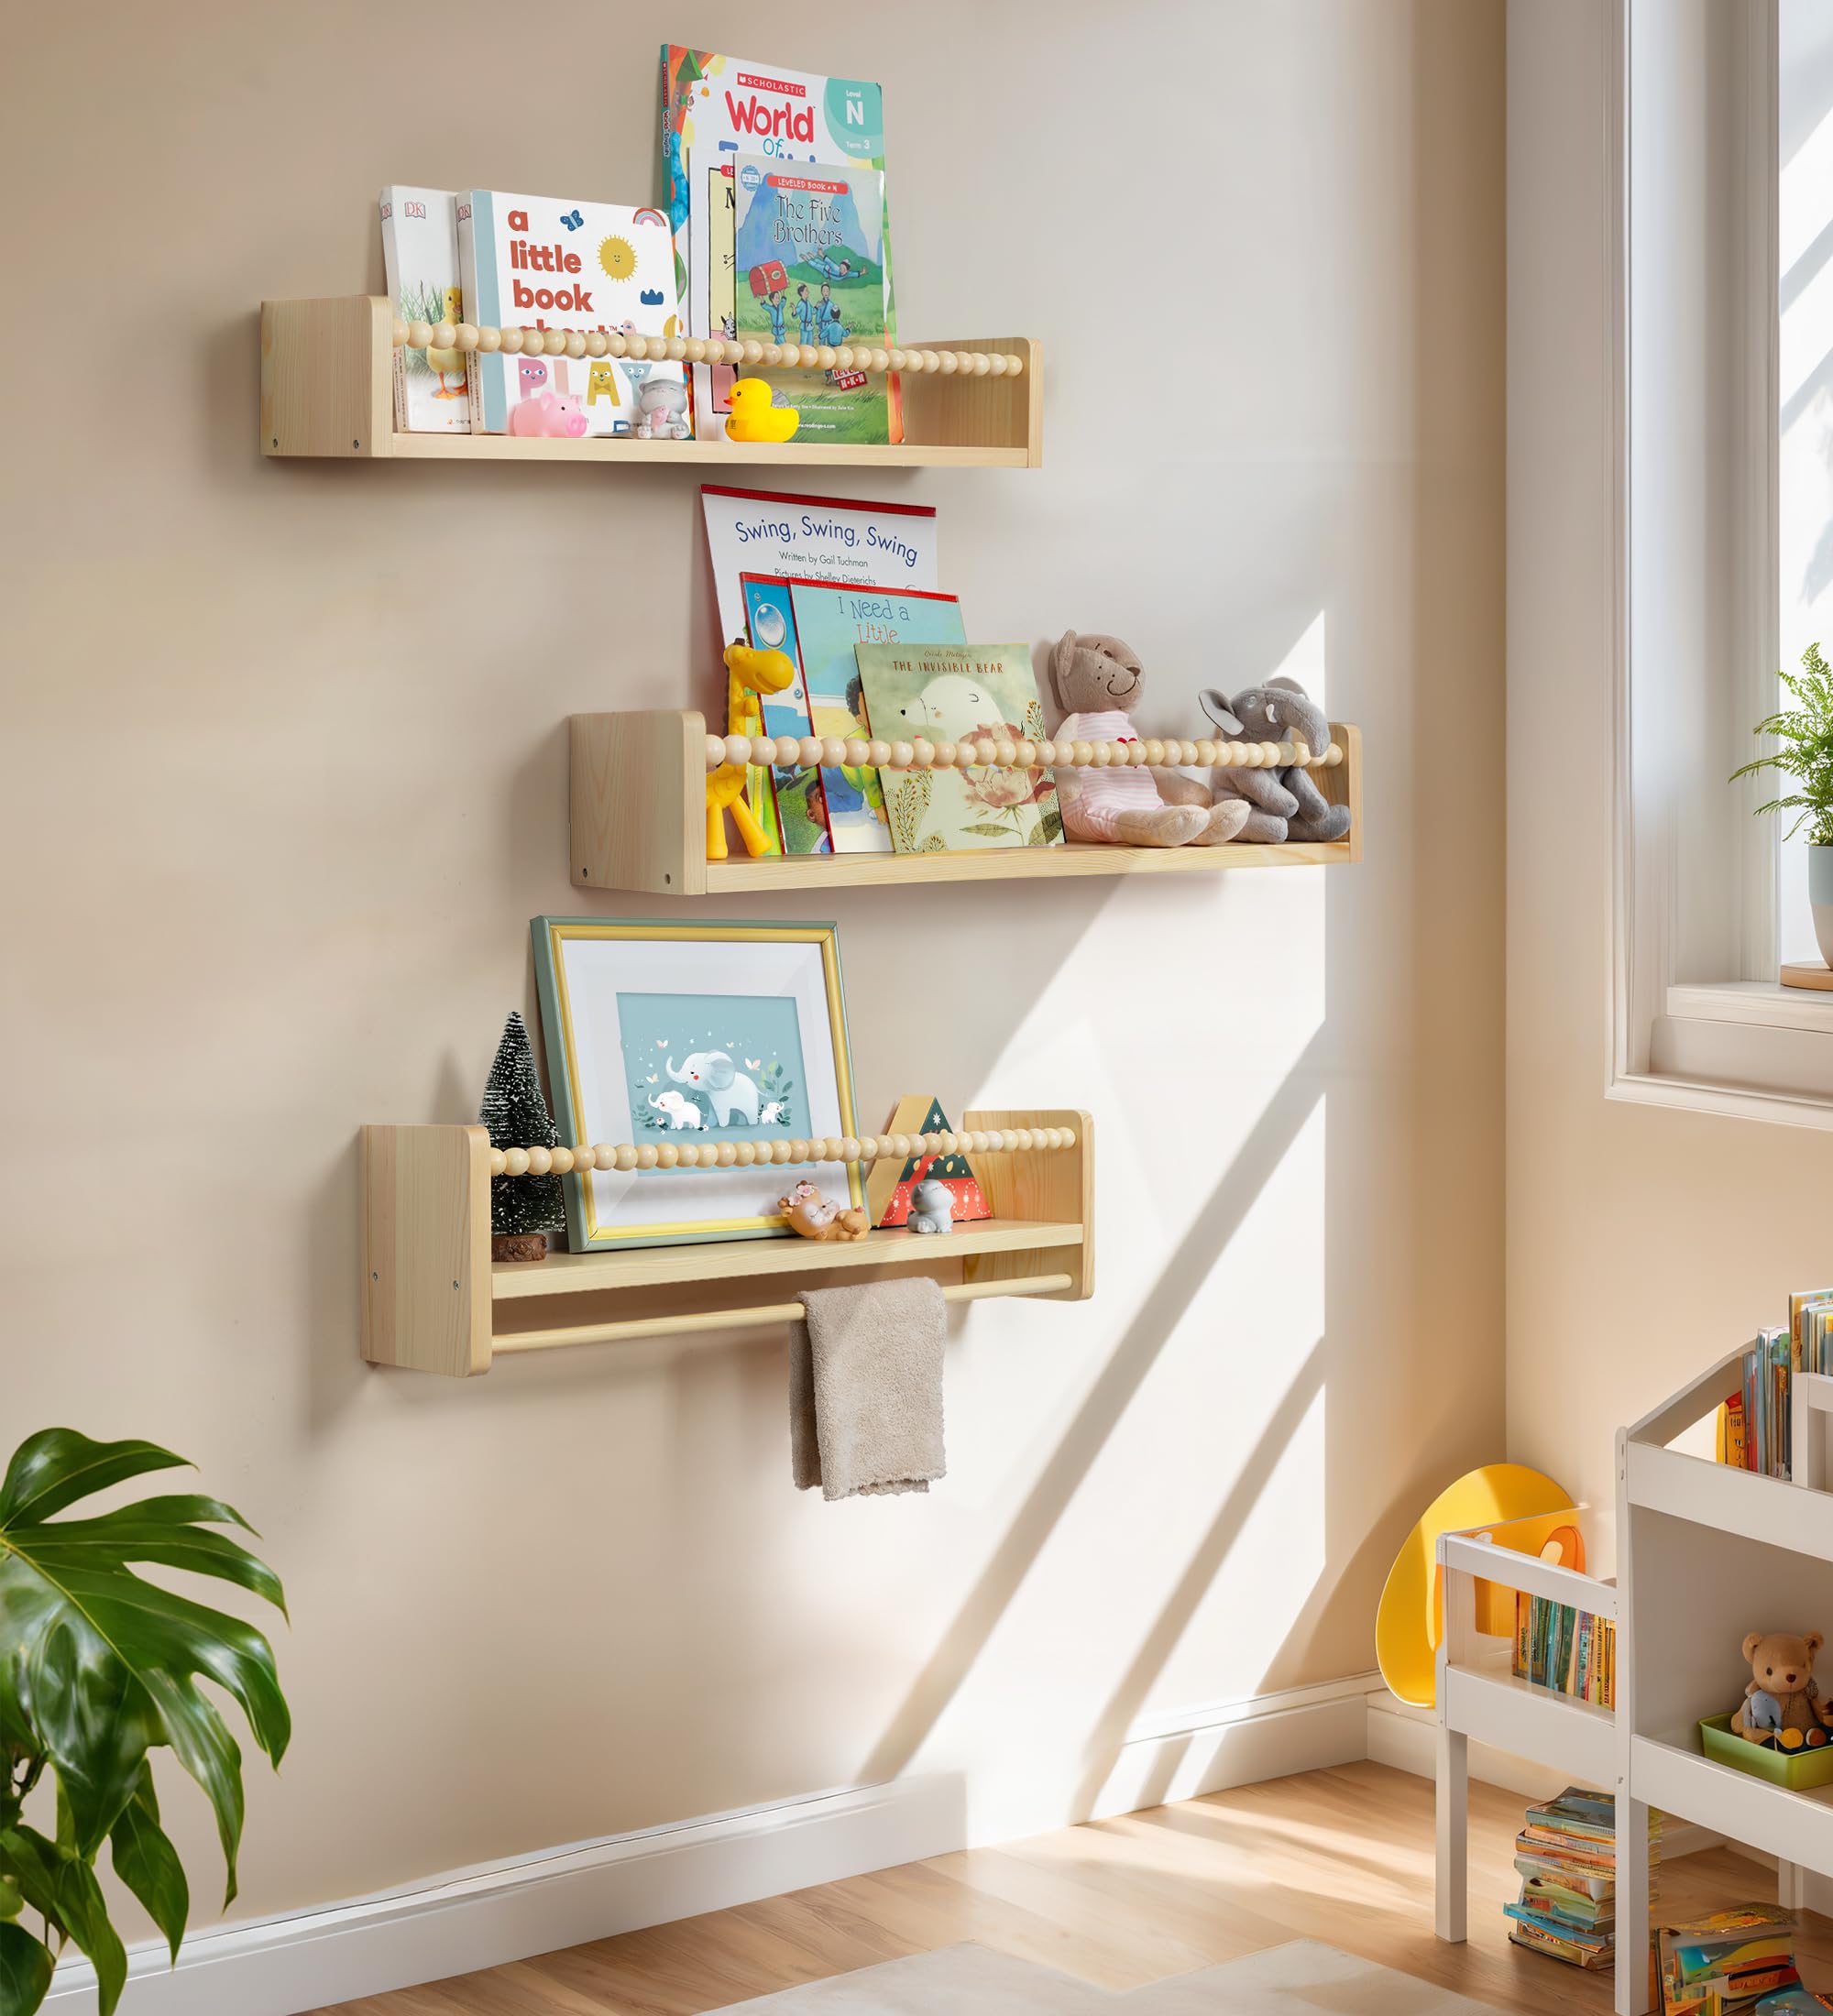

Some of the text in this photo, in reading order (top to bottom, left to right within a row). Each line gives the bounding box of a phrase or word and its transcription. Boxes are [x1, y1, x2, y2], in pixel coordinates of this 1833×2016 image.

[747, 77, 806, 95] SCHOLASTIC
[845, 90, 862, 98] Level
[725, 90, 814, 143] World
[846, 100, 864, 126] N
[863, 139, 870, 149] 3
[777, 177, 838, 192] LEVELED BOOK N
[405, 203, 425, 217] DK
[458, 204, 471, 219] DK
[508, 210, 529, 232] a
[774, 195, 841, 225] The Five
[774, 219, 843, 247] Brothers
[510, 240, 582, 274] little
[512, 279, 594, 312] book
[735, 515, 918, 568] Swing, Swing, Swing
[778, 551, 869, 568] Written by Gail Tuchman
[774, 567, 876, 586] Pictures by Shelley Dieterichs
[838, 596, 910, 621] I Need a
[857, 621, 901, 644] Little
[892, 661, 1004, 674] THE INVISIBLE BEAR
